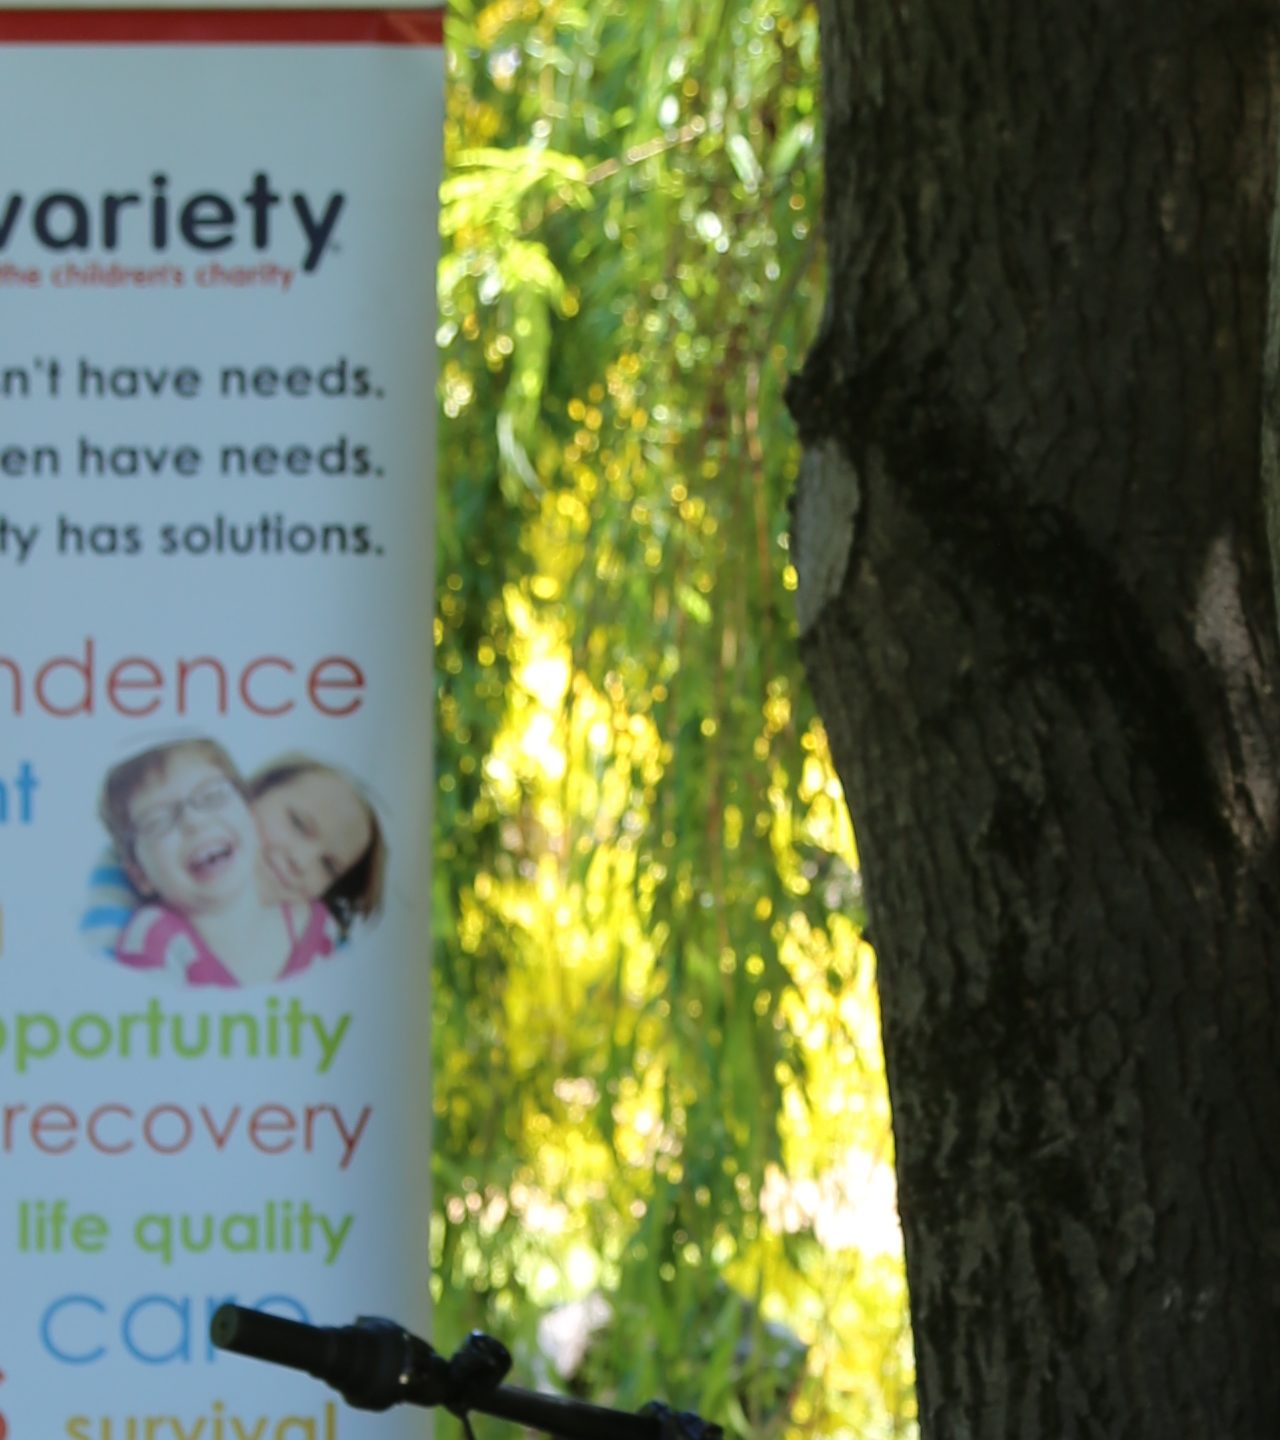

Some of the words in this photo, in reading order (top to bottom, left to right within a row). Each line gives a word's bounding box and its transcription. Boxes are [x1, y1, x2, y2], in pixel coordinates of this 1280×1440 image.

[51, 263, 185, 289] children's
[195, 263, 295, 293] charity
[78, 359, 201, 398] have
[220, 358, 383, 398] needs.
[79, 437, 202, 476] have
[220, 436, 383, 476] needs.
[58, 515, 142, 555] has
[160, 514, 384, 555] solutions.
[3, 1103, 372, 1168] recovery
[18, 1200, 109, 1253] life
[134, 1200, 354, 1265] quality
